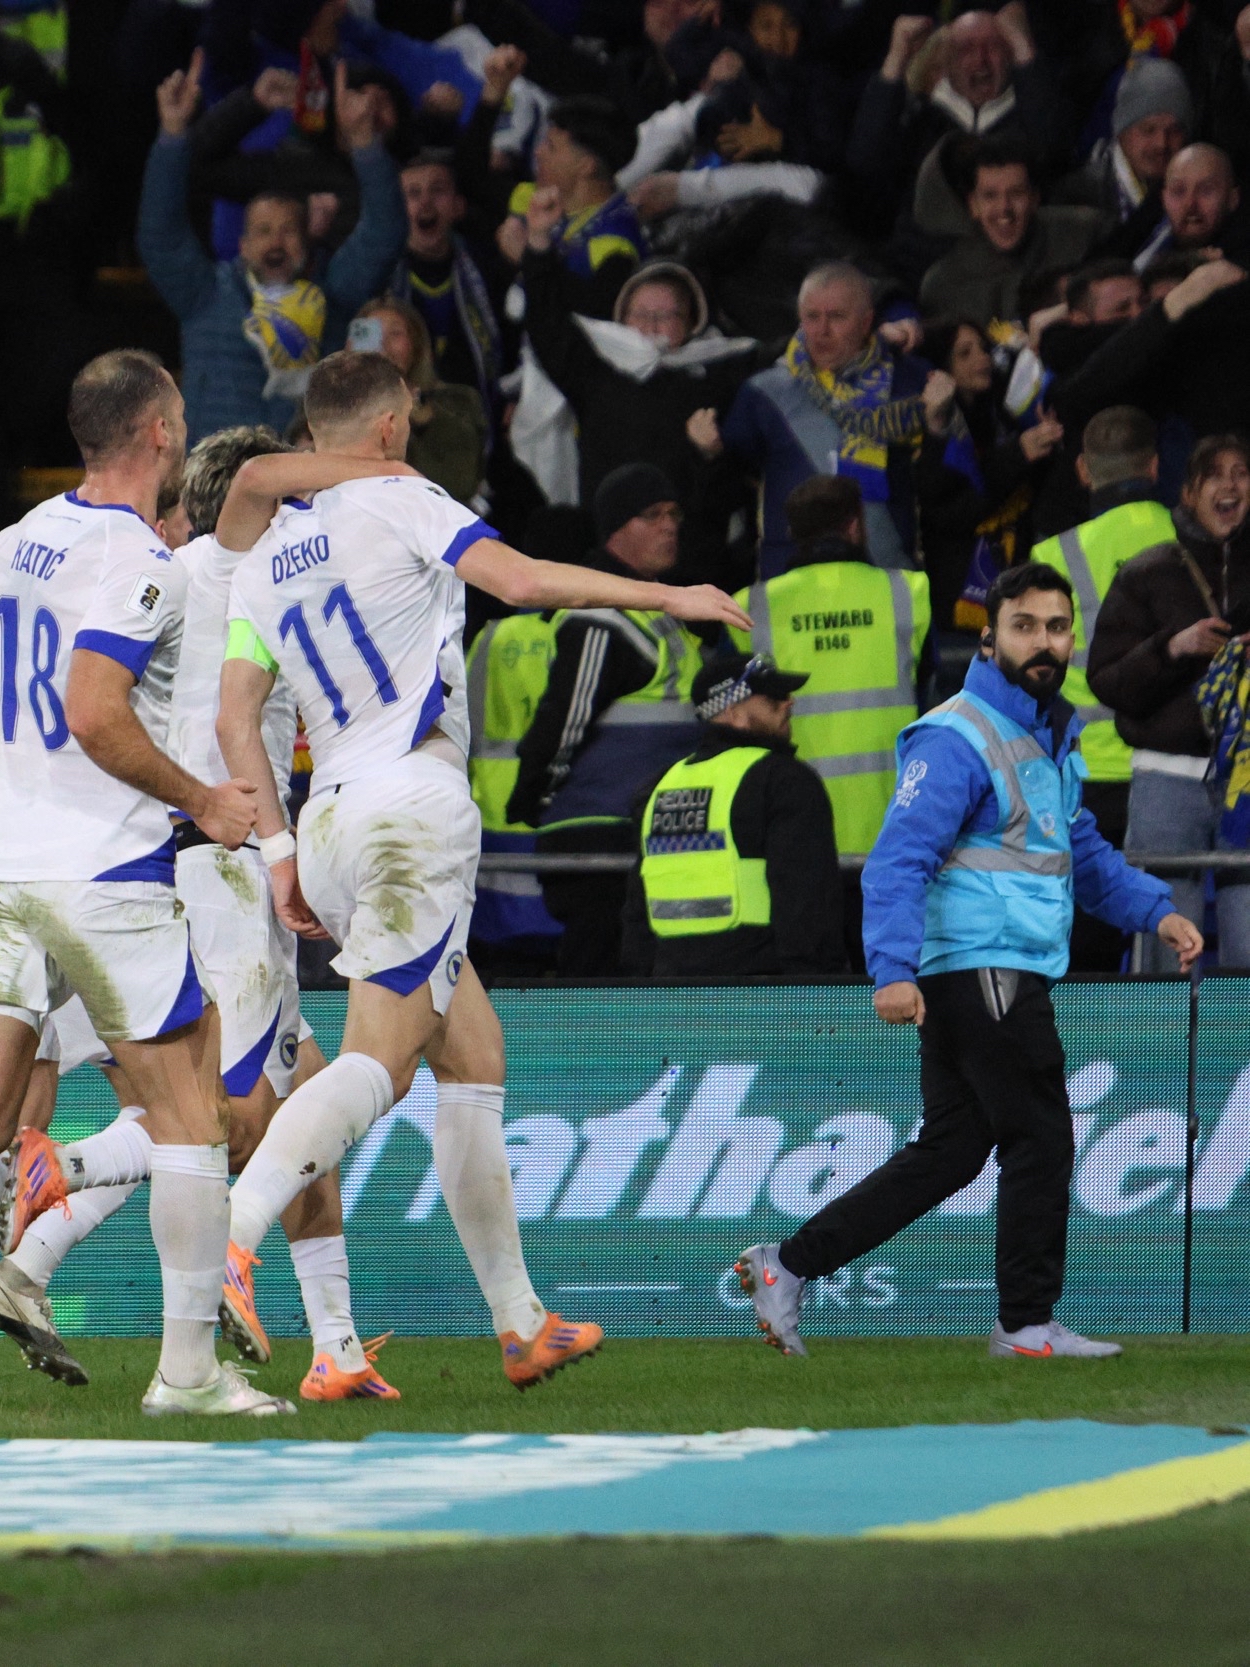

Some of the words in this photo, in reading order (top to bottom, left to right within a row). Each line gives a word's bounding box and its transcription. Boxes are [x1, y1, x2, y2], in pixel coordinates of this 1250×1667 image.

[10, 538, 69, 581] KATIĆ
[271, 534, 330, 585] DŽEKO
[791, 608, 874, 632] STEWARD
[276, 580, 401, 730] 11
[652, 809, 706, 832] POLICE
[656, 789, 709, 811] HEDDLU
[717, 1261, 900, 1309] CRS
